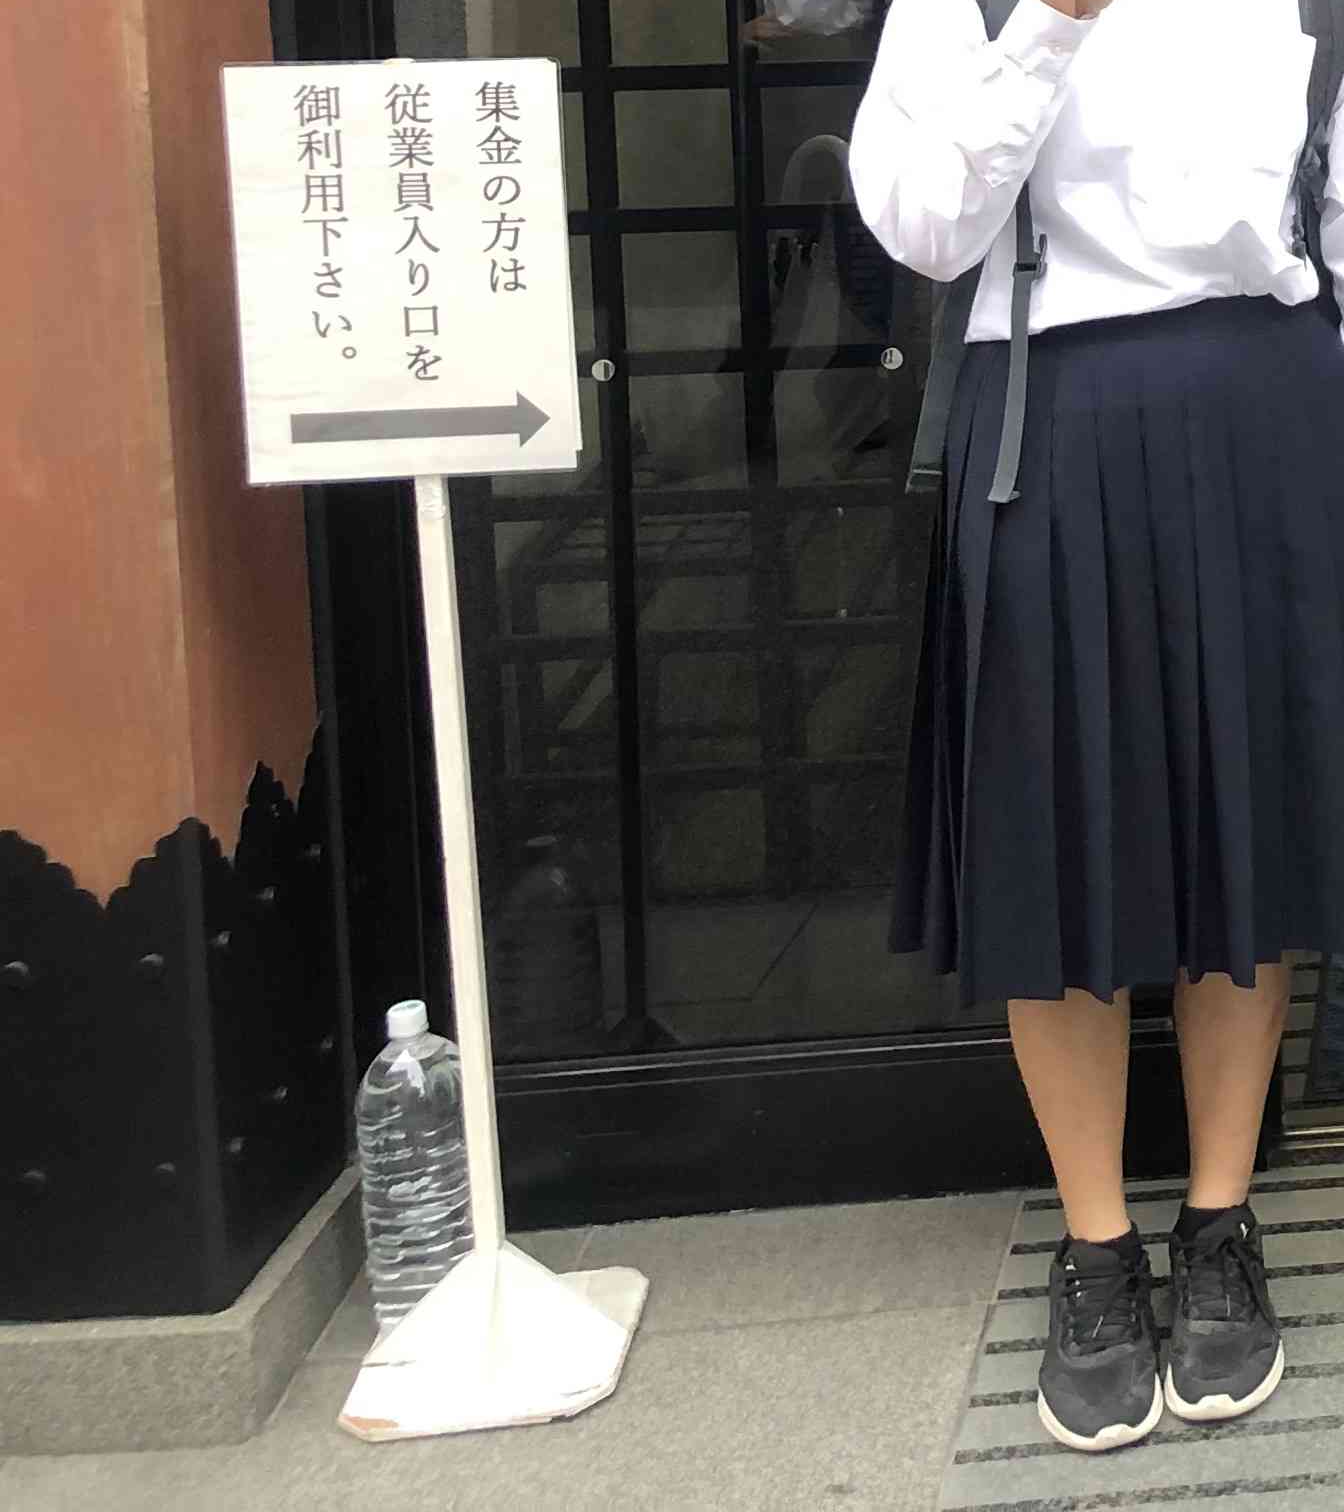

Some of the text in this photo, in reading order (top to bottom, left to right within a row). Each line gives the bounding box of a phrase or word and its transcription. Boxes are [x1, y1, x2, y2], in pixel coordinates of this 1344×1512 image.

[293, 84, 357, 361] 御利用下さい。
[384, 83, 443, 381] 従業員入り口を
[475, 81, 528, 294] 集金の方は
